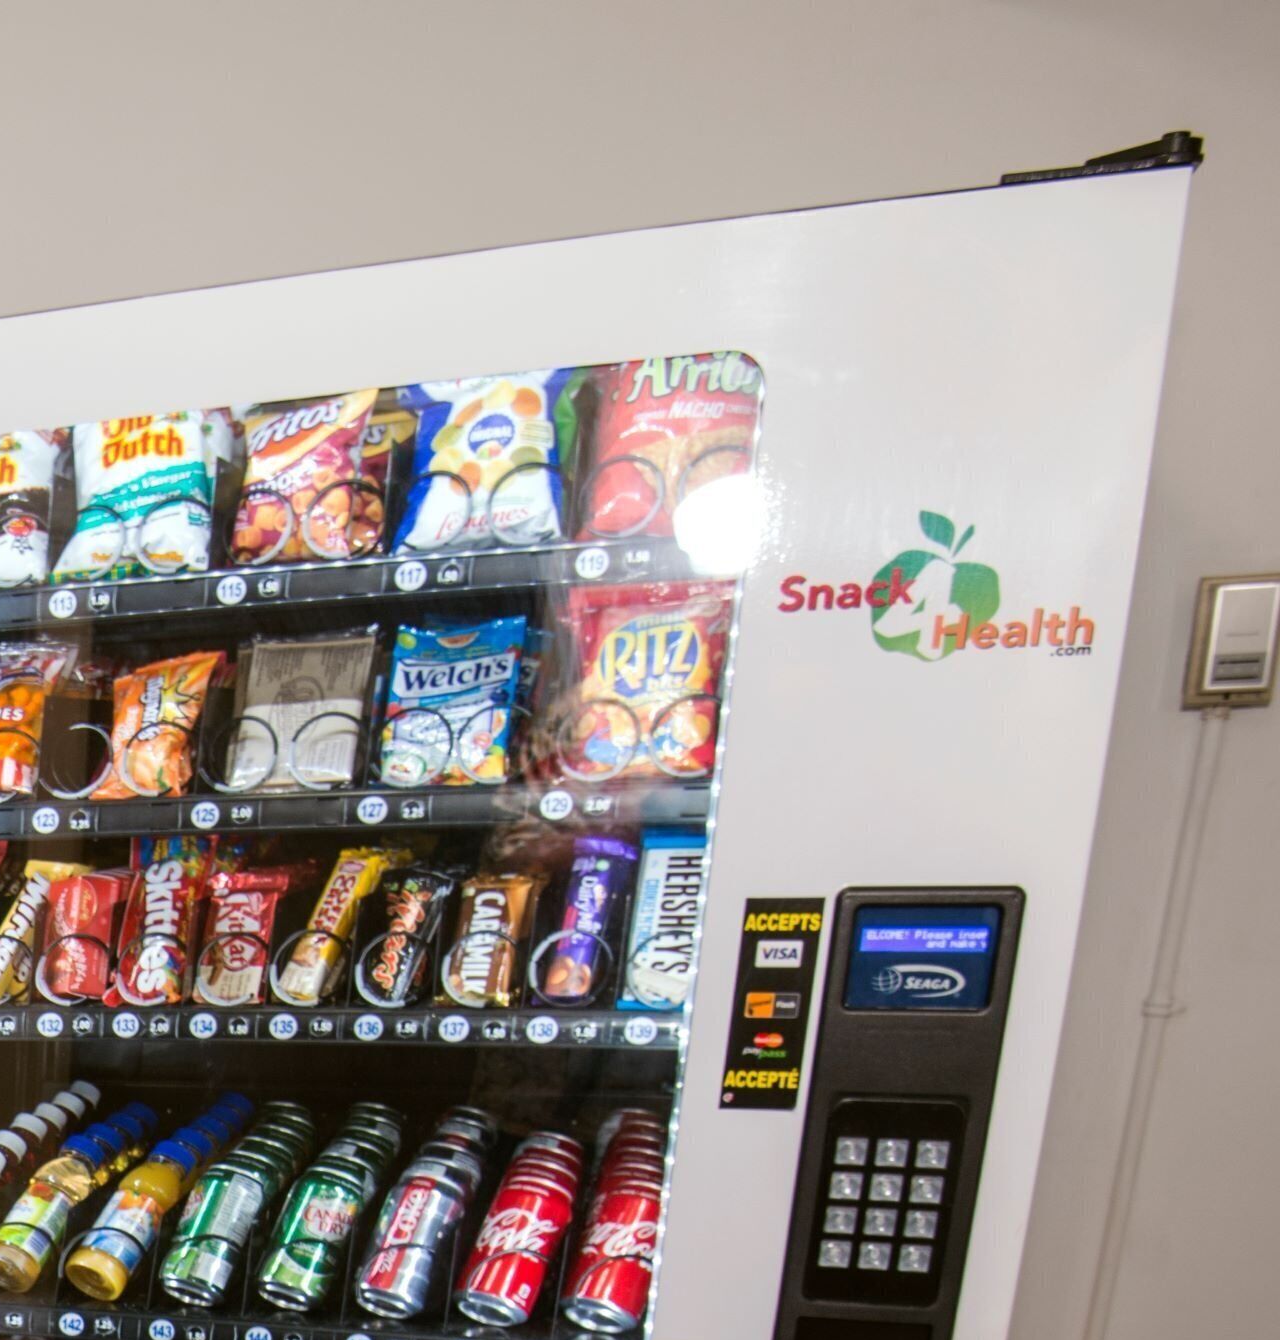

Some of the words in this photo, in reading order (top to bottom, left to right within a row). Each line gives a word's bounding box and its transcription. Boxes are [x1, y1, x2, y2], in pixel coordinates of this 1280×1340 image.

[667, 400, 725, 419] NACHO
[248, 398, 345, 454] Fritos
[101, 424, 184, 469] Dutch
[578, 554, 604, 571] 119
[397, 568, 423, 585] 117
[219, 582, 243, 598] 115
[777, 567, 917, 614] Snack
[53, 598, 72, 611] 113
[931, 606, 1096, 651] Health
[1049, 645, 1093, 658] .com
[603, 622, 693, 690] RITZ
[401, 658, 509, 692] Welch's
[360, 803, 384, 817] 127
[543, 797, 570, 813] 129
[36, 813, 56, 828] 123
[195, 808, 216, 822] 125
[650, 854, 705, 975] HERSHEY'S
[744, 913, 822, 932] ACCEPTS
[135, 860, 185, 994] Skittles
[914, 929, 954, 941] Please
[459, 890, 506, 995] CARAMILK
[761, 946, 798, 961] VISA
[904, 976, 952, 990] SEAGA
[40, 1018, 61, 1032] 132
[116, 1018, 136, 1032] 133
[192, 1018, 215, 1033] 134
[272, 1018, 294, 1033] 135
[357, 1019, 380, 1034] 136
[441, 1020, 465, 1035] 137
[529, 1022, 554, 1037] 138
[627, 1023, 652, 1038] 139
[724, 1068, 800, 1090] ACCEPTÉ
[386, 1189, 429, 1245] Coke
[317, 1220, 344, 1238] DRY
[61, 1317, 82, 1331] 142
[151, 1324, 173, 1338] 143
